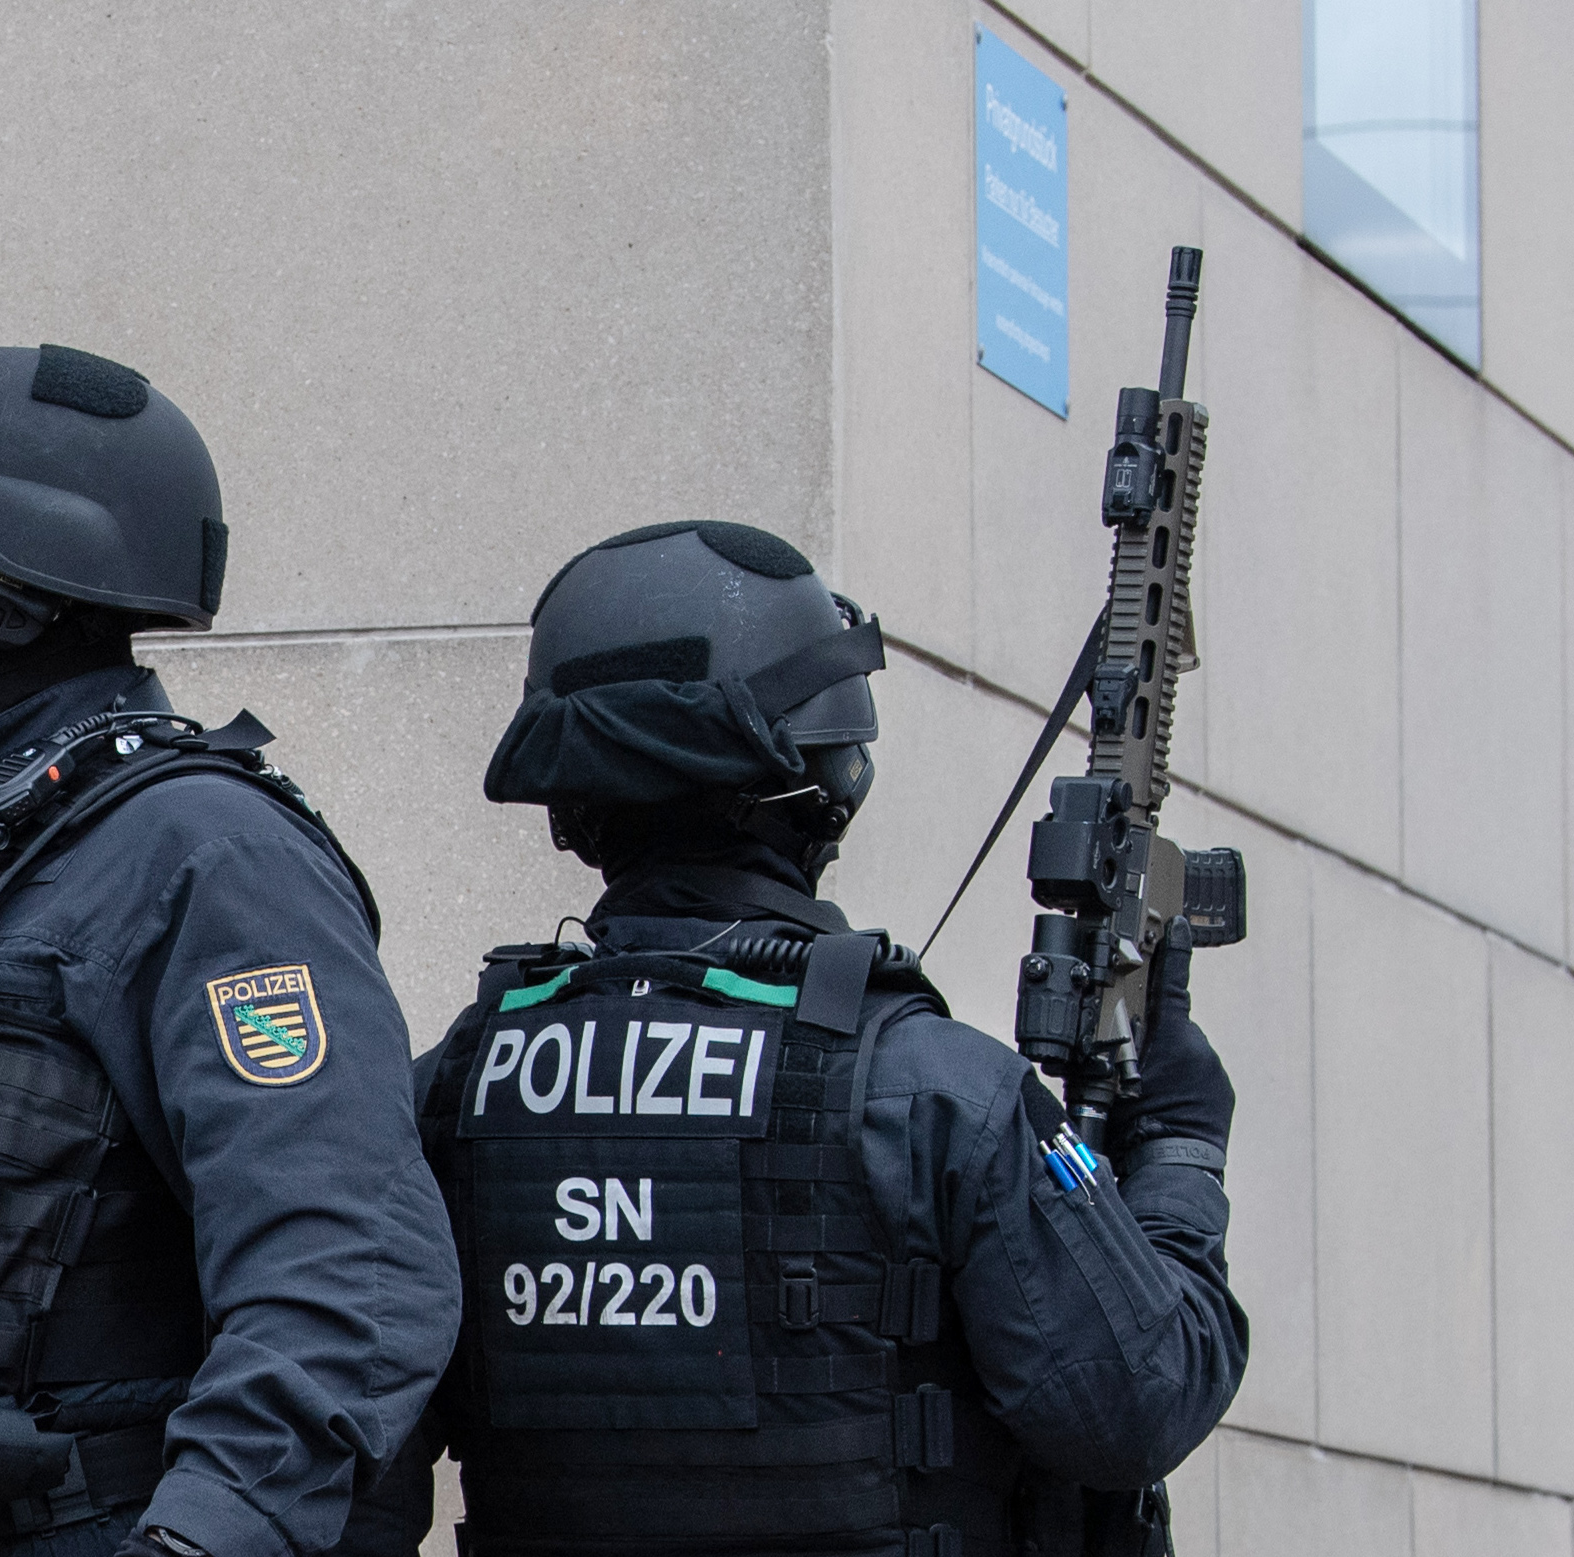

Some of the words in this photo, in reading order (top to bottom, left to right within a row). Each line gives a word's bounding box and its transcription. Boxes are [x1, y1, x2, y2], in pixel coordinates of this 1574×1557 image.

[217, 973, 306, 1006] POLIZEI
[473, 1020, 766, 1117] POLIZEI
[554, 1176, 652, 1242] SN
[503, 1261, 716, 1328] 92/220
